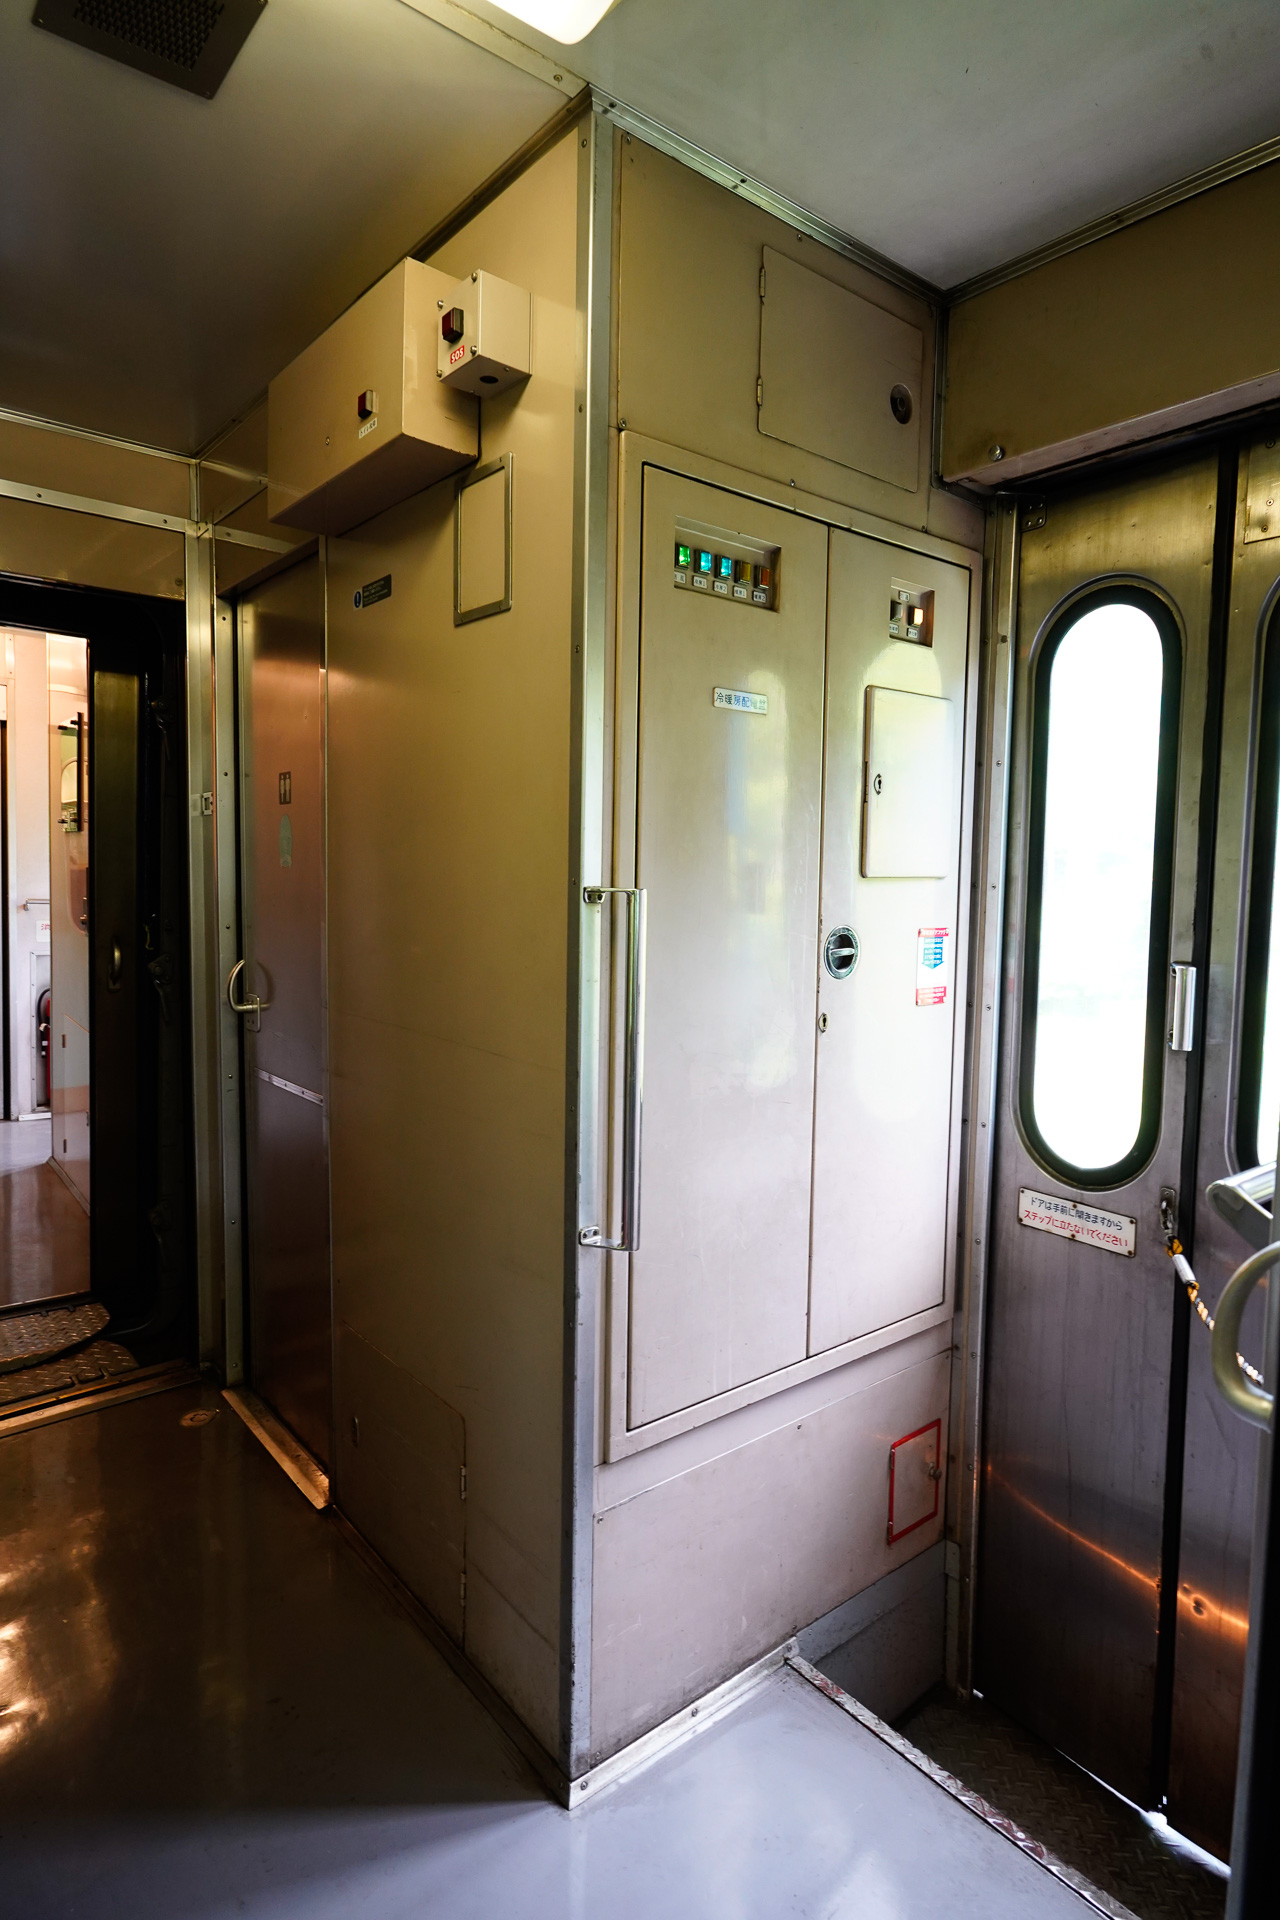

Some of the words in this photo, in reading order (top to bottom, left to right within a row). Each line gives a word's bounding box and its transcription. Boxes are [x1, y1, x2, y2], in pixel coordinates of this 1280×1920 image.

[451, 347, 464, 363] SOS
[715, 692, 766, 710] 冷暖房配電盤
[1030, 1196, 1123, 1231] ドアは手前に開きますから
[1023, 1209, 1128, 1247] ステップに立たないでください
